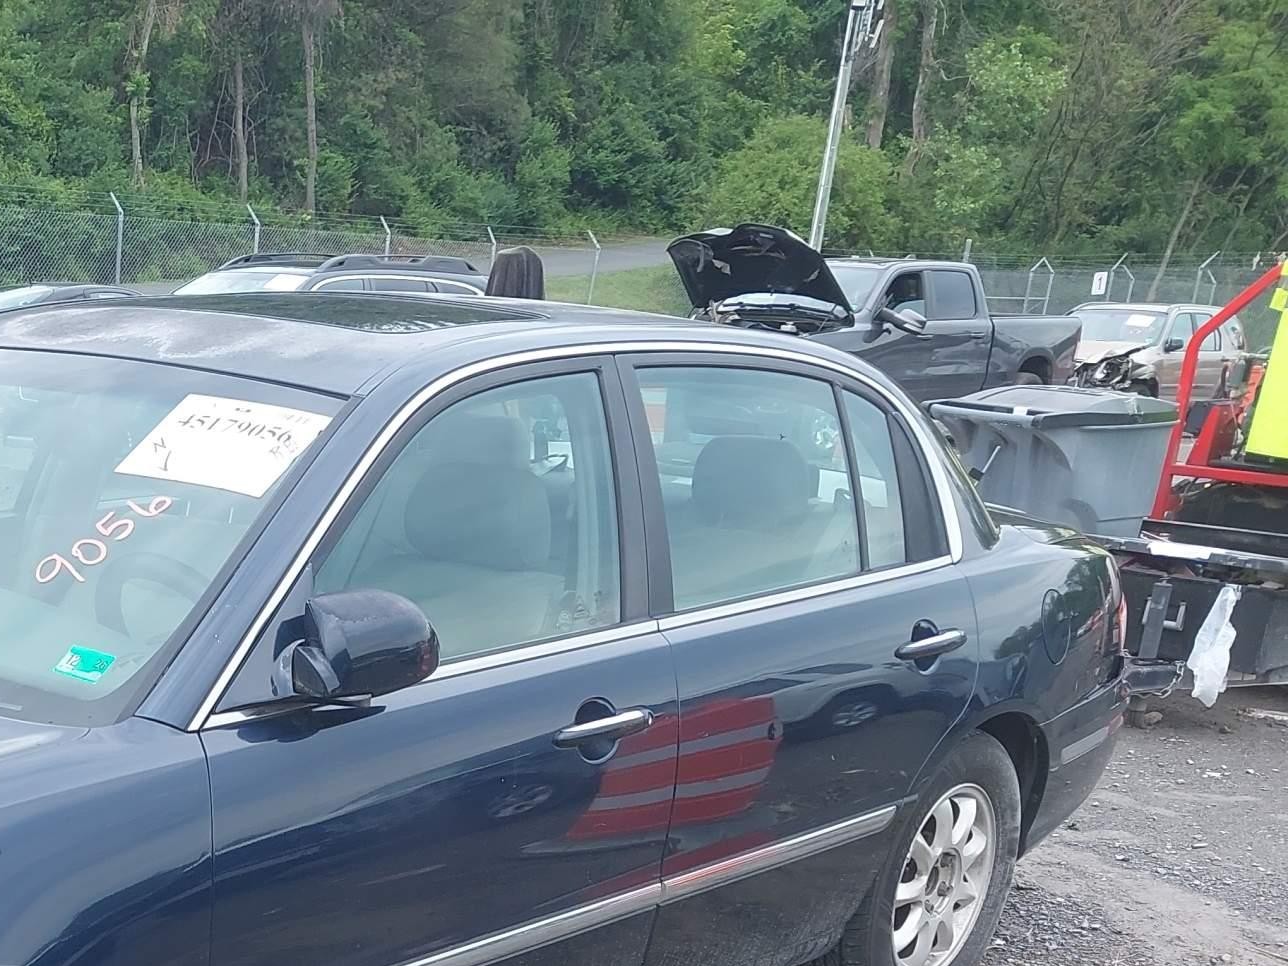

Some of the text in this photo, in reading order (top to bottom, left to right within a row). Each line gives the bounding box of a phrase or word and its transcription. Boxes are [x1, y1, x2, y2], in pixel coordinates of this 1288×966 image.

[1097, 276, 1103, 290] 1
[178, 413, 292, 443] 45179056
[34, 495, 173, 584] 9056
